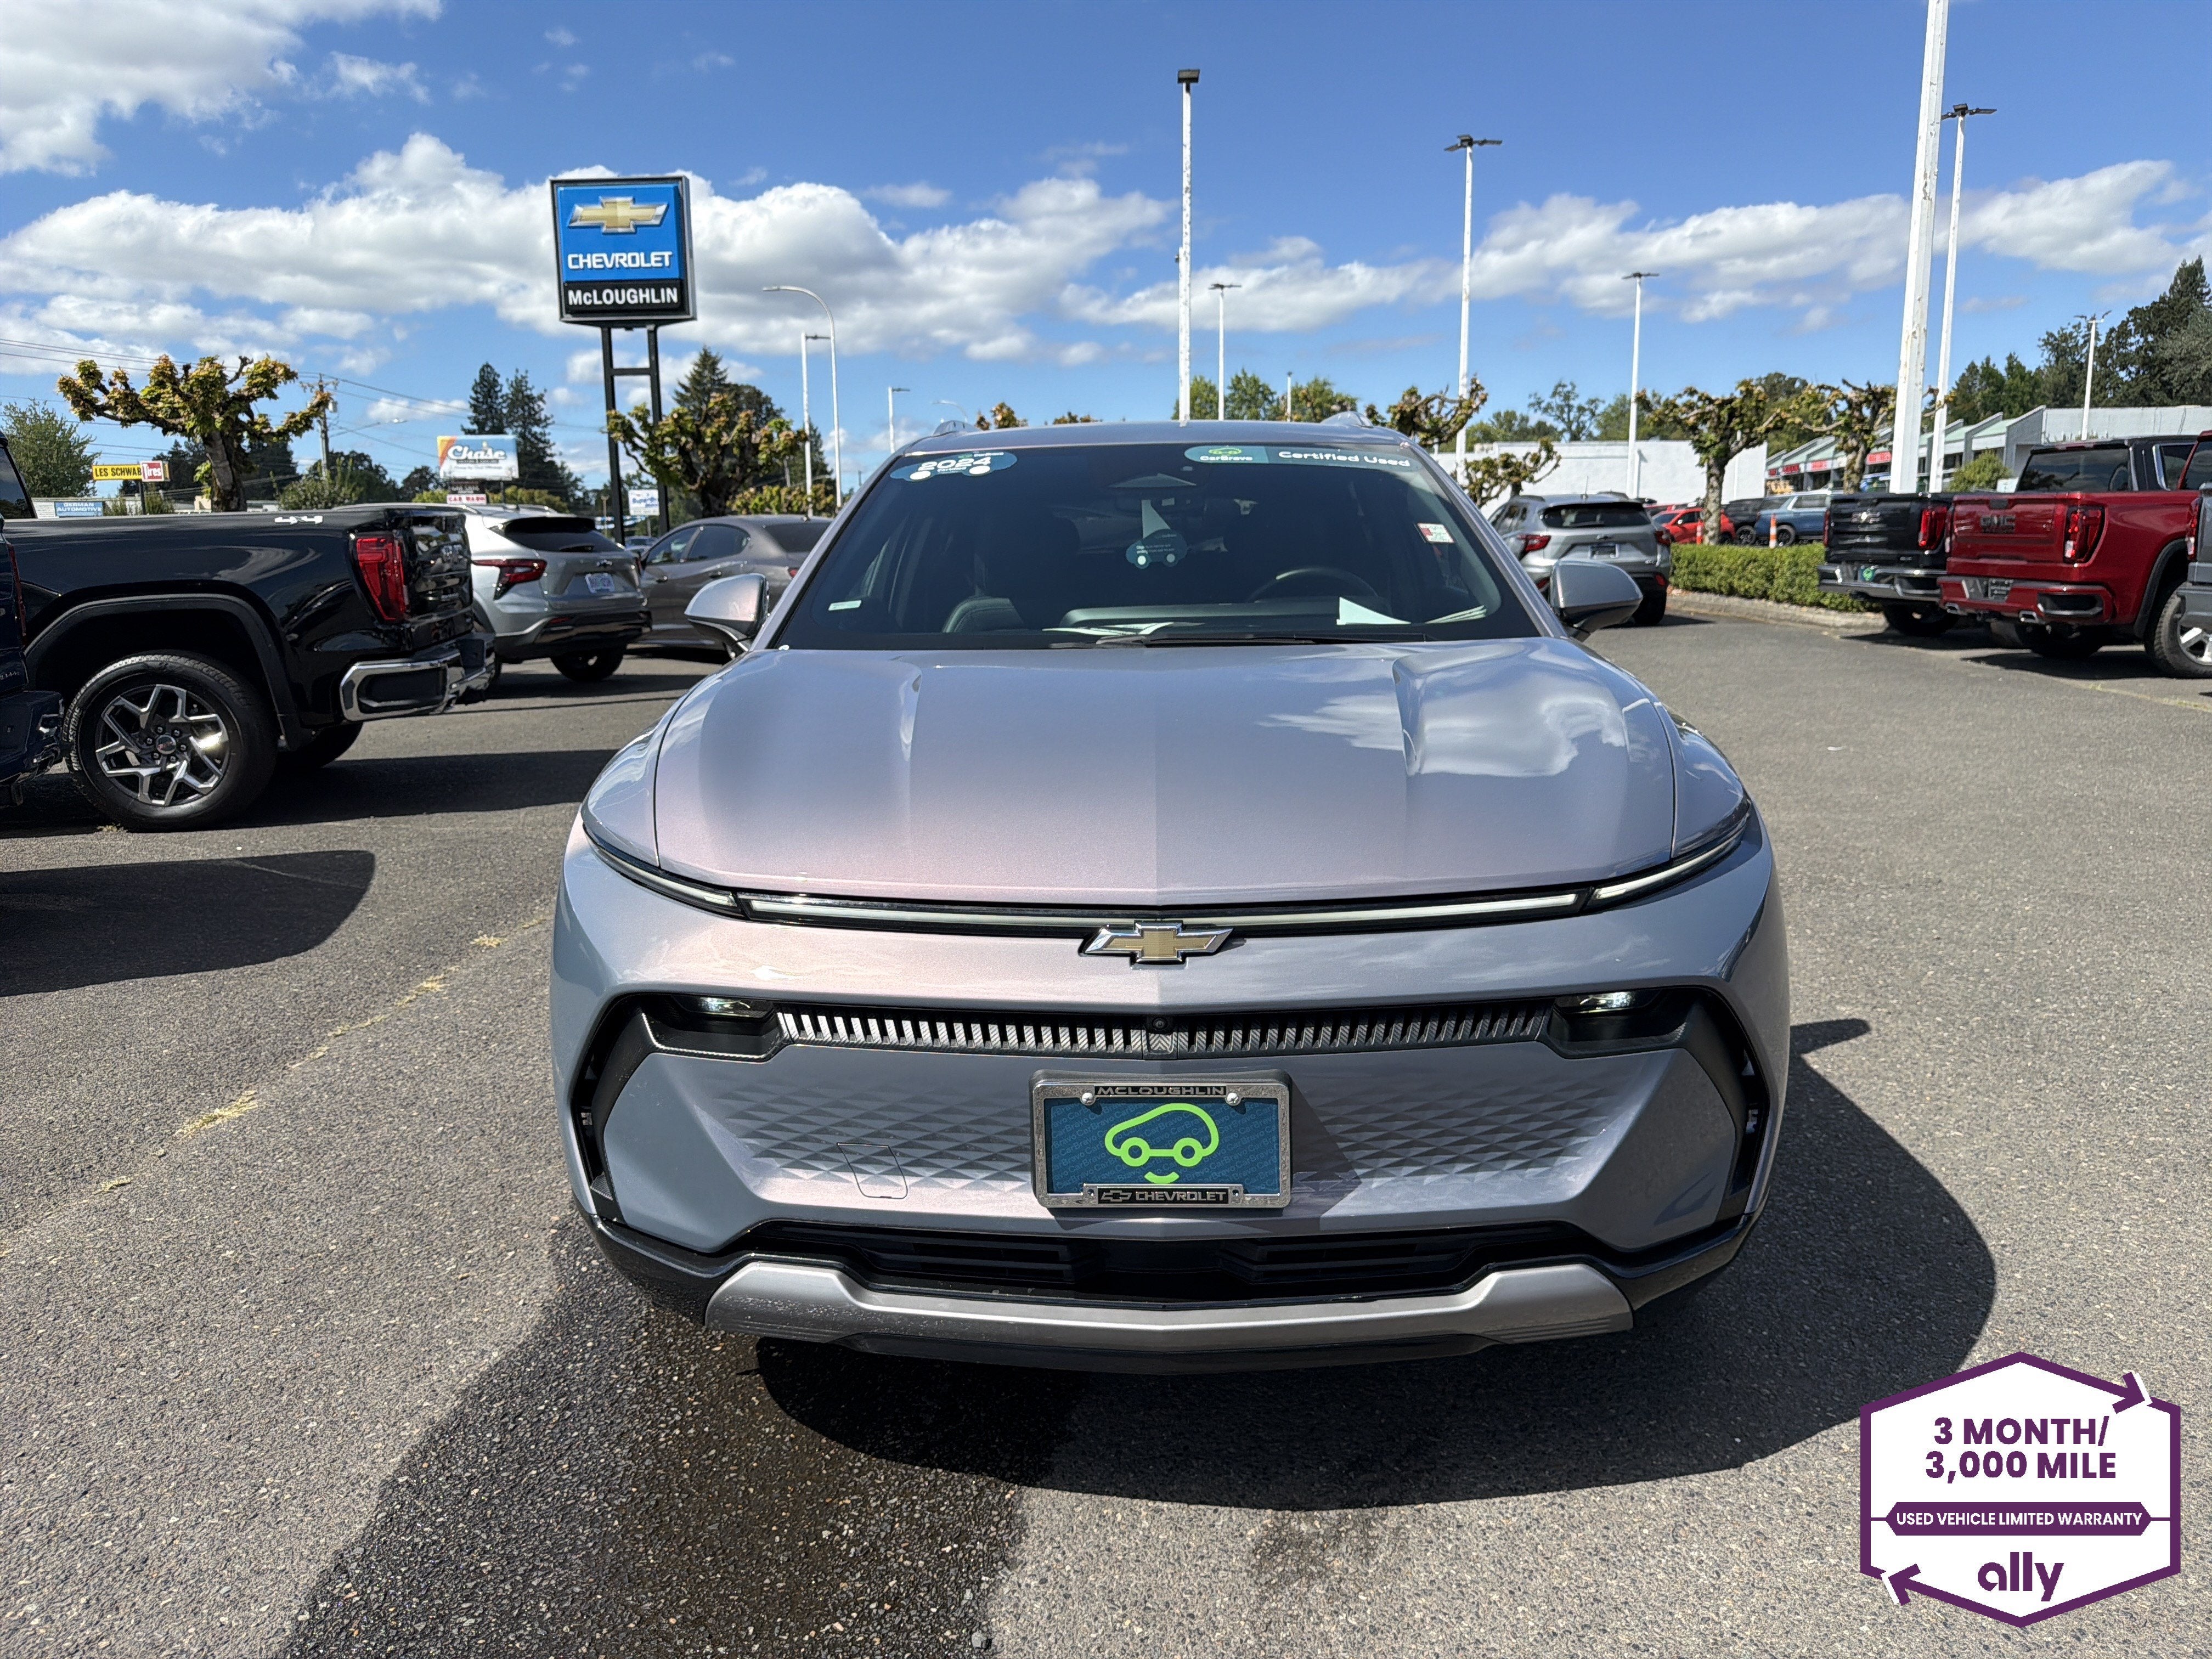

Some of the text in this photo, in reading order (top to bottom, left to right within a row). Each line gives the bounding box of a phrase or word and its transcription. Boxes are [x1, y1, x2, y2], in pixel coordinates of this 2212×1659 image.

[567, 251, 673, 269] CHEVROLET
[568, 287, 678, 305] McLOUGHLIN
[447, 445, 506, 460] Chase
[1279, 451, 1410, 467] Certified Used
[918, 456, 991, 471] 2024
[95, 467, 142, 477] LES SCHWAB
[143, 464, 161, 479] Tires
[1097, 1087, 1224, 1096] MCLOUGHLIN
[1135, 1191, 1227, 1201] CHEVROLET
